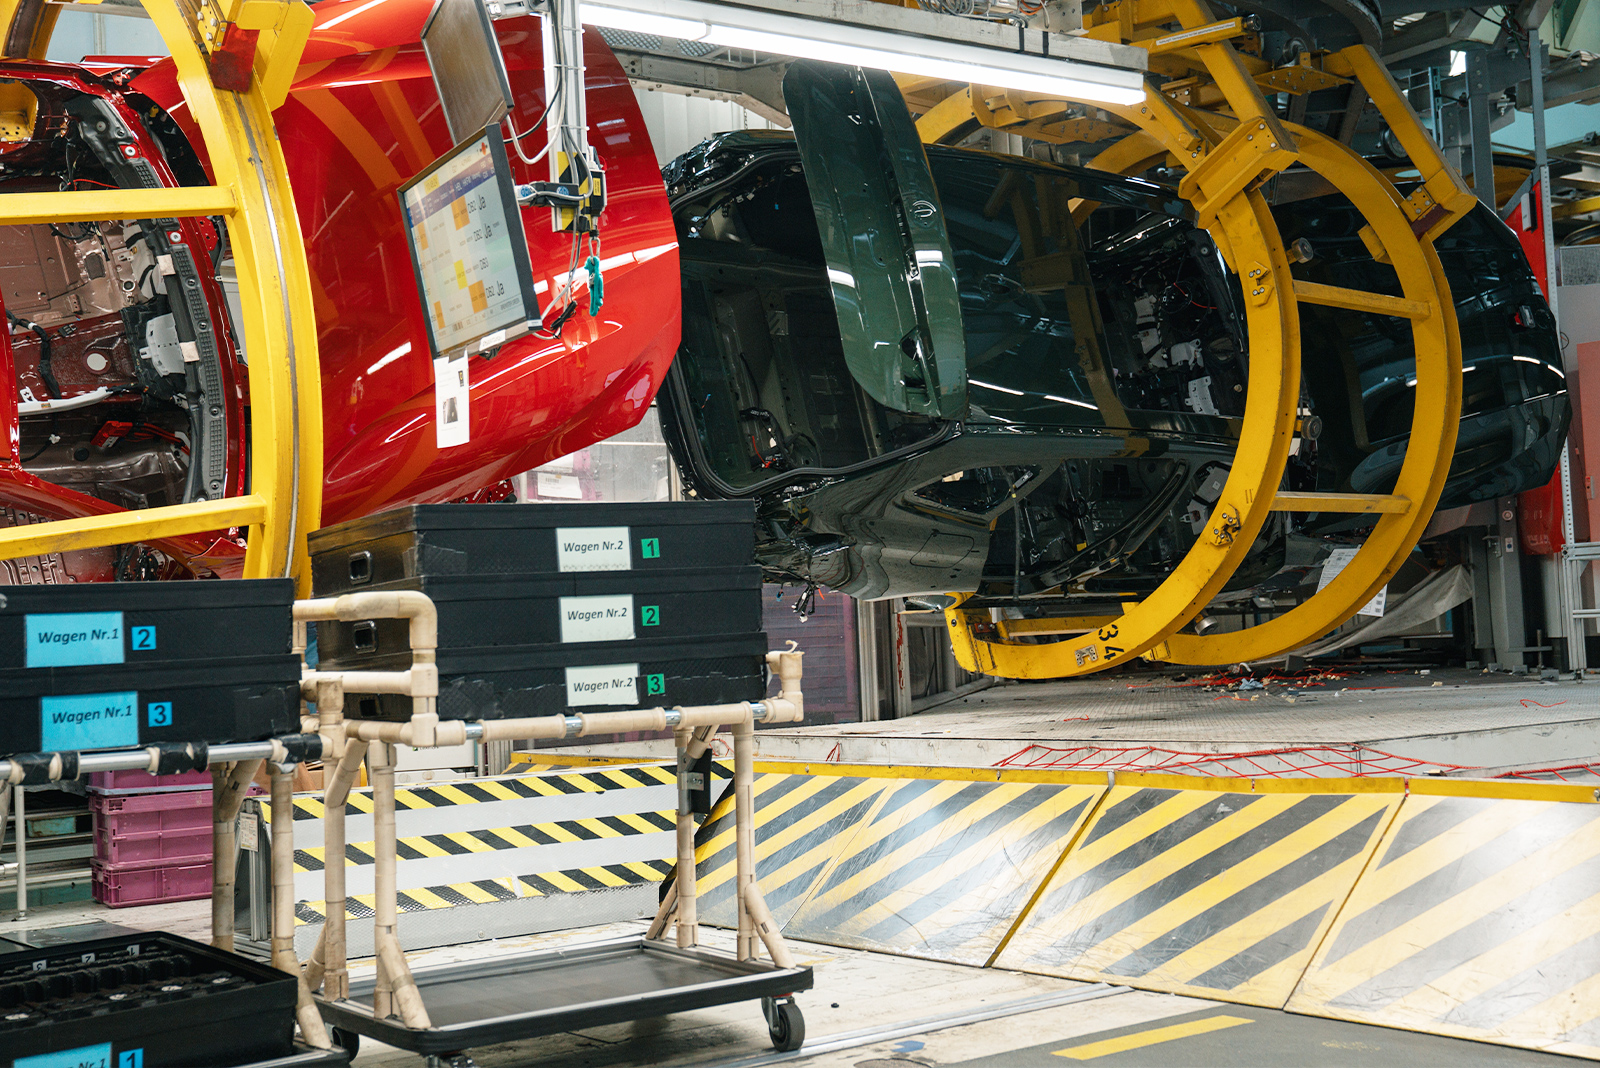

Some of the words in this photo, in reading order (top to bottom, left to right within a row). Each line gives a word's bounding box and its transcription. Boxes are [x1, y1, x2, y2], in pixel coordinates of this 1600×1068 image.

[478, 194, 486, 210] Ja
[484, 223, 492, 239] Ja
[496, 280, 505, 297] Ja
[563, 542, 599, 554] Wagen
[602, 540, 624, 551] Nr.2
[647, 540, 655, 557] 1
[567, 610, 603, 622] Wagen
[606, 608, 627, 618] Nr.2
[646, 608, 656, 625] 2
[38, 630, 87, 645] Wagen
[90, 628, 119, 641] Nr.1
[137, 629, 151, 648] 2
[573, 681, 609, 693] Wagen
[611, 677, 633, 688] Nr.2
[650, 676, 660, 692] 3
[52, 710, 100, 725] Wagen
[104, 705, 132, 718] Nr.1
[153, 705, 167, 724] 3
[126, 1052, 136, 1068] 1
